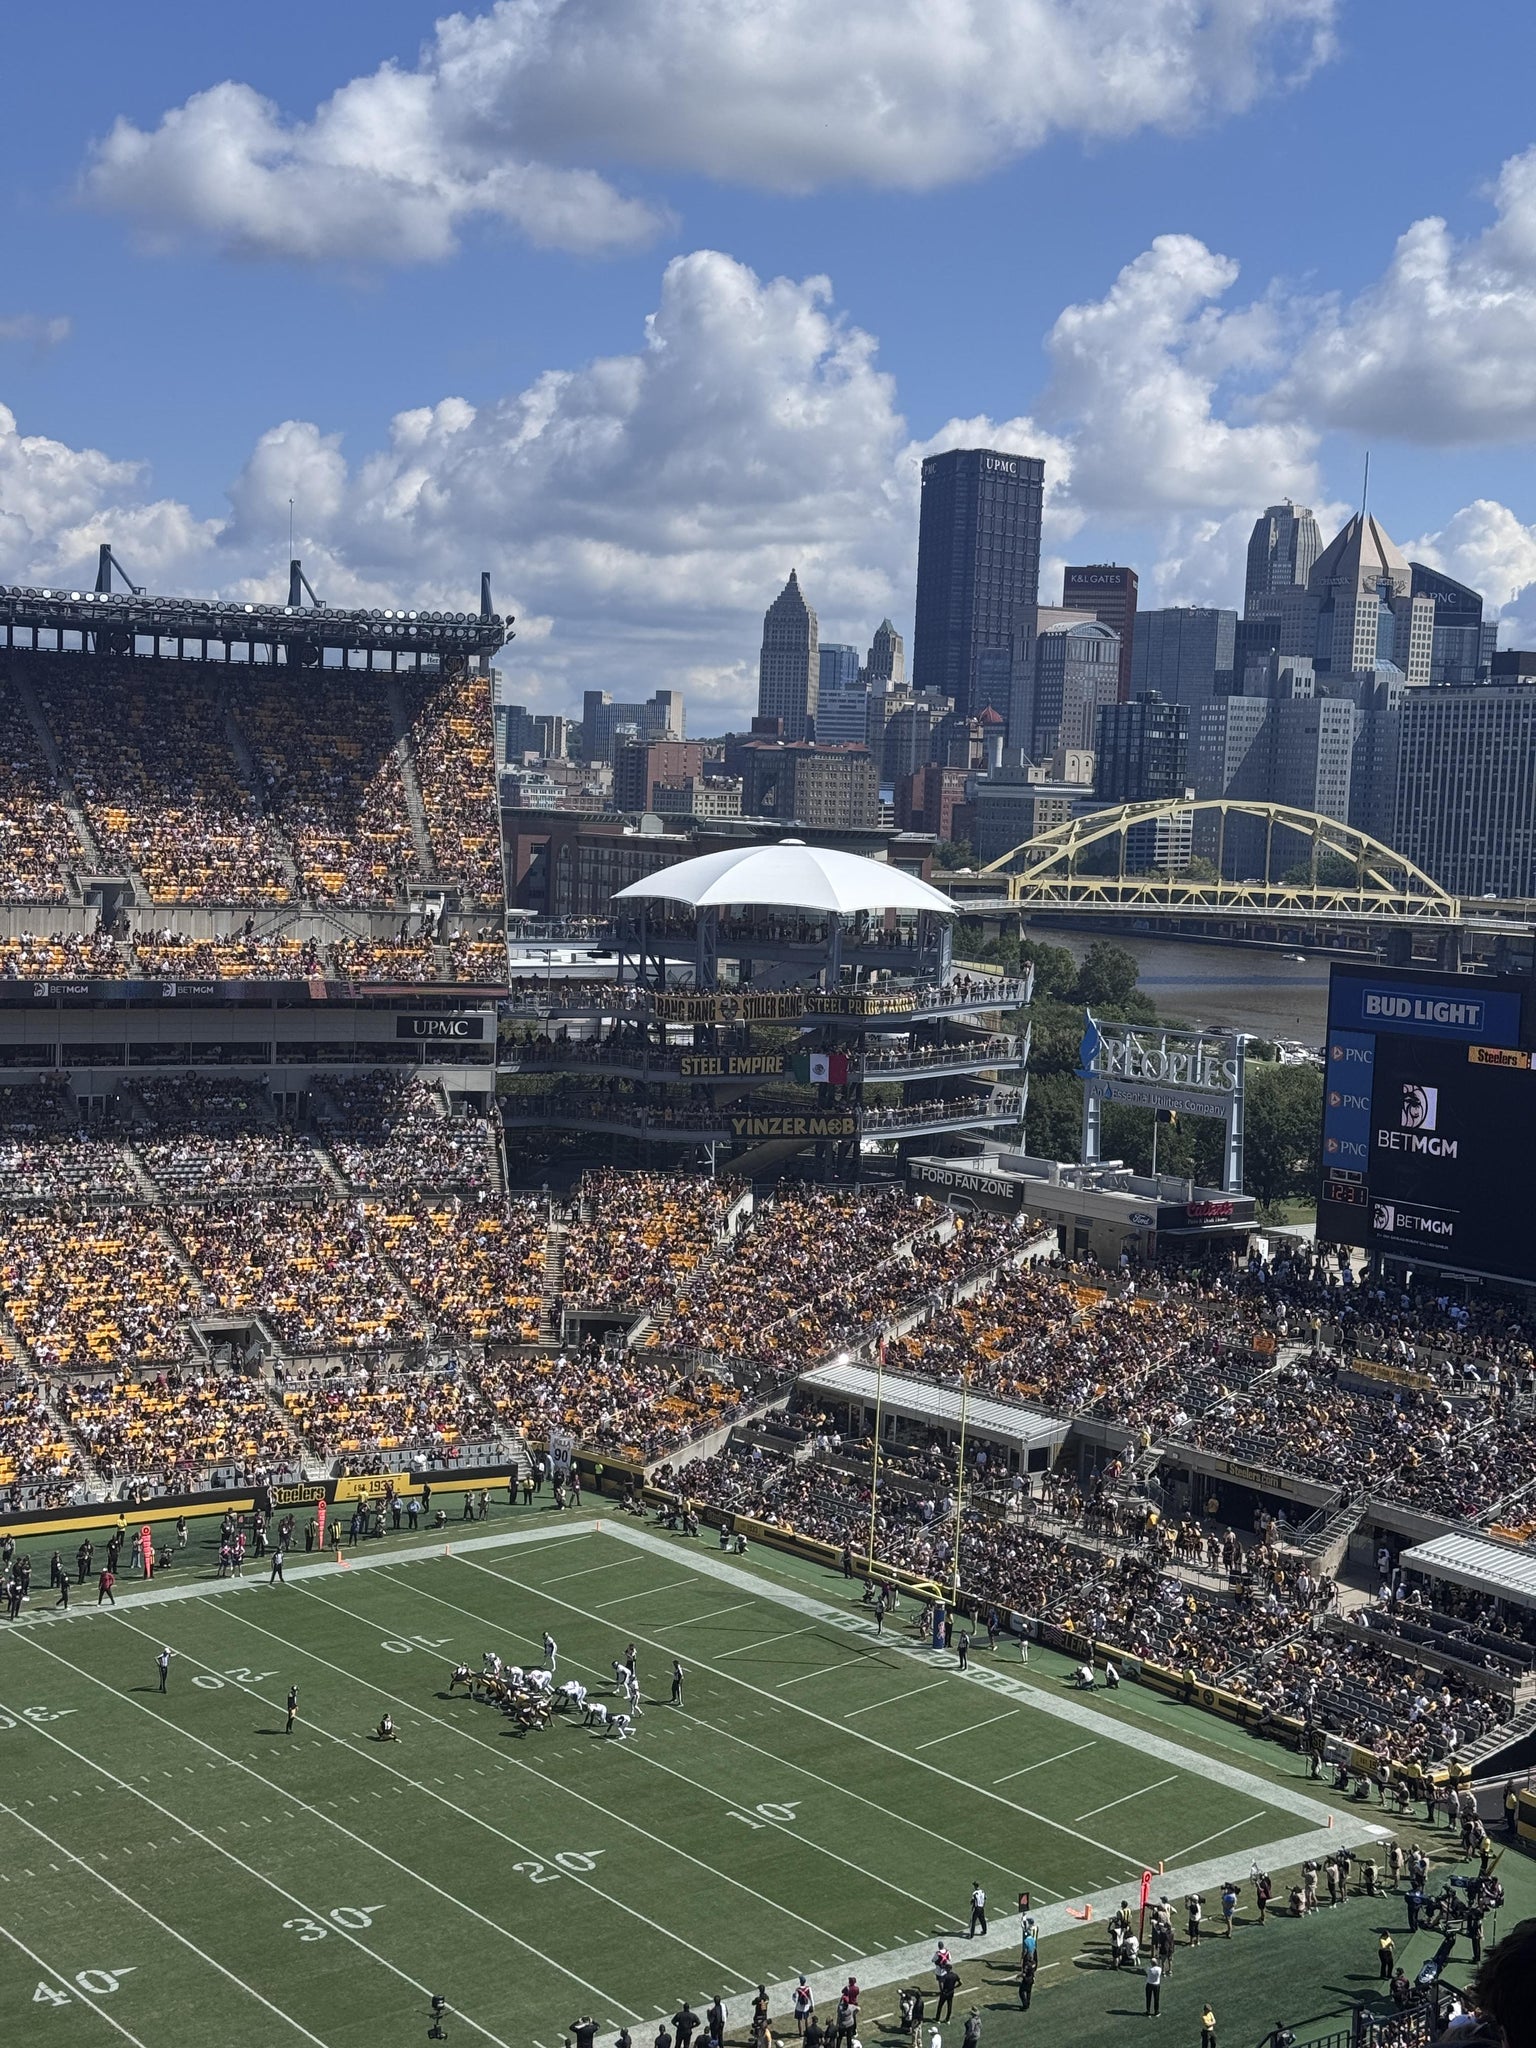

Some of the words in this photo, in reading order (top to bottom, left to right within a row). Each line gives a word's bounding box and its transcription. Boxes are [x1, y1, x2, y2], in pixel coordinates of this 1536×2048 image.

[986, 457, 1017, 474] UPMC
[1071, 574, 1089, 584] K&L
[1090, 574, 1121, 584] GATES
[1430, 591, 1457, 605] PNC
[50, 985, 89, 994] BETMGM
[177, 985, 214, 994] BETMGM
[688, 999, 716, 1021] BANG
[743, 997, 777, 1019] STILLER
[778, 995, 802, 1018] GANG
[808, 997, 845, 1014] STEEL
[848, 998, 881, 1015] PRIDE
[1366, 994, 1412, 1018] BUD
[1414, 999, 1480, 1026] LIGHT
[413, 1020, 469, 1036] UPMC
[1105, 1038, 1237, 1093] PEOPLES
[1345, 1048, 1373, 1064] PNC
[1477, 1048, 1518, 1066] Steelers
[681, 1057, 725, 1075] STEEL
[729, 1057, 784, 1074] EMPIRE
[1112, 1088, 1151, 1104] Essential
[1151, 1094, 1183, 1109] Utilities
[1184, 1100, 1226, 1117] Company
[1343, 1095, 1370, 1111] PNC
[731, 1117, 806, 1136] YINZER
[808, 1117, 857, 1135] MOB
[1340, 1141, 1367, 1158] PNC
[1378, 1129, 1458, 1159] BETMGM
[921, 1167, 953, 1186] FORD
[955, 1174, 979, 1192] FAN
[980, 1179, 1014, 1198] ZONE
[1331, 1184, 1364, 1204] 12:31
[1131, 1213, 1151, 1226] Ford
[1396, 1213, 1453, 1236] BETMGM
[554, 1448, 568, 1463] 90
[1229, 1463, 1279, 1489] Steelers.com
[272, 1483, 326, 1505] Steelers
[369, 1479, 395, 1493] 1933
[911, 1648, 1035, 1696] FOGET
[726, 1802, 798, 1829] 10
[512, 1851, 597, 1883] 20
[282, 1907, 373, 1942] 30
[32, 1969, 120, 2007] 40
